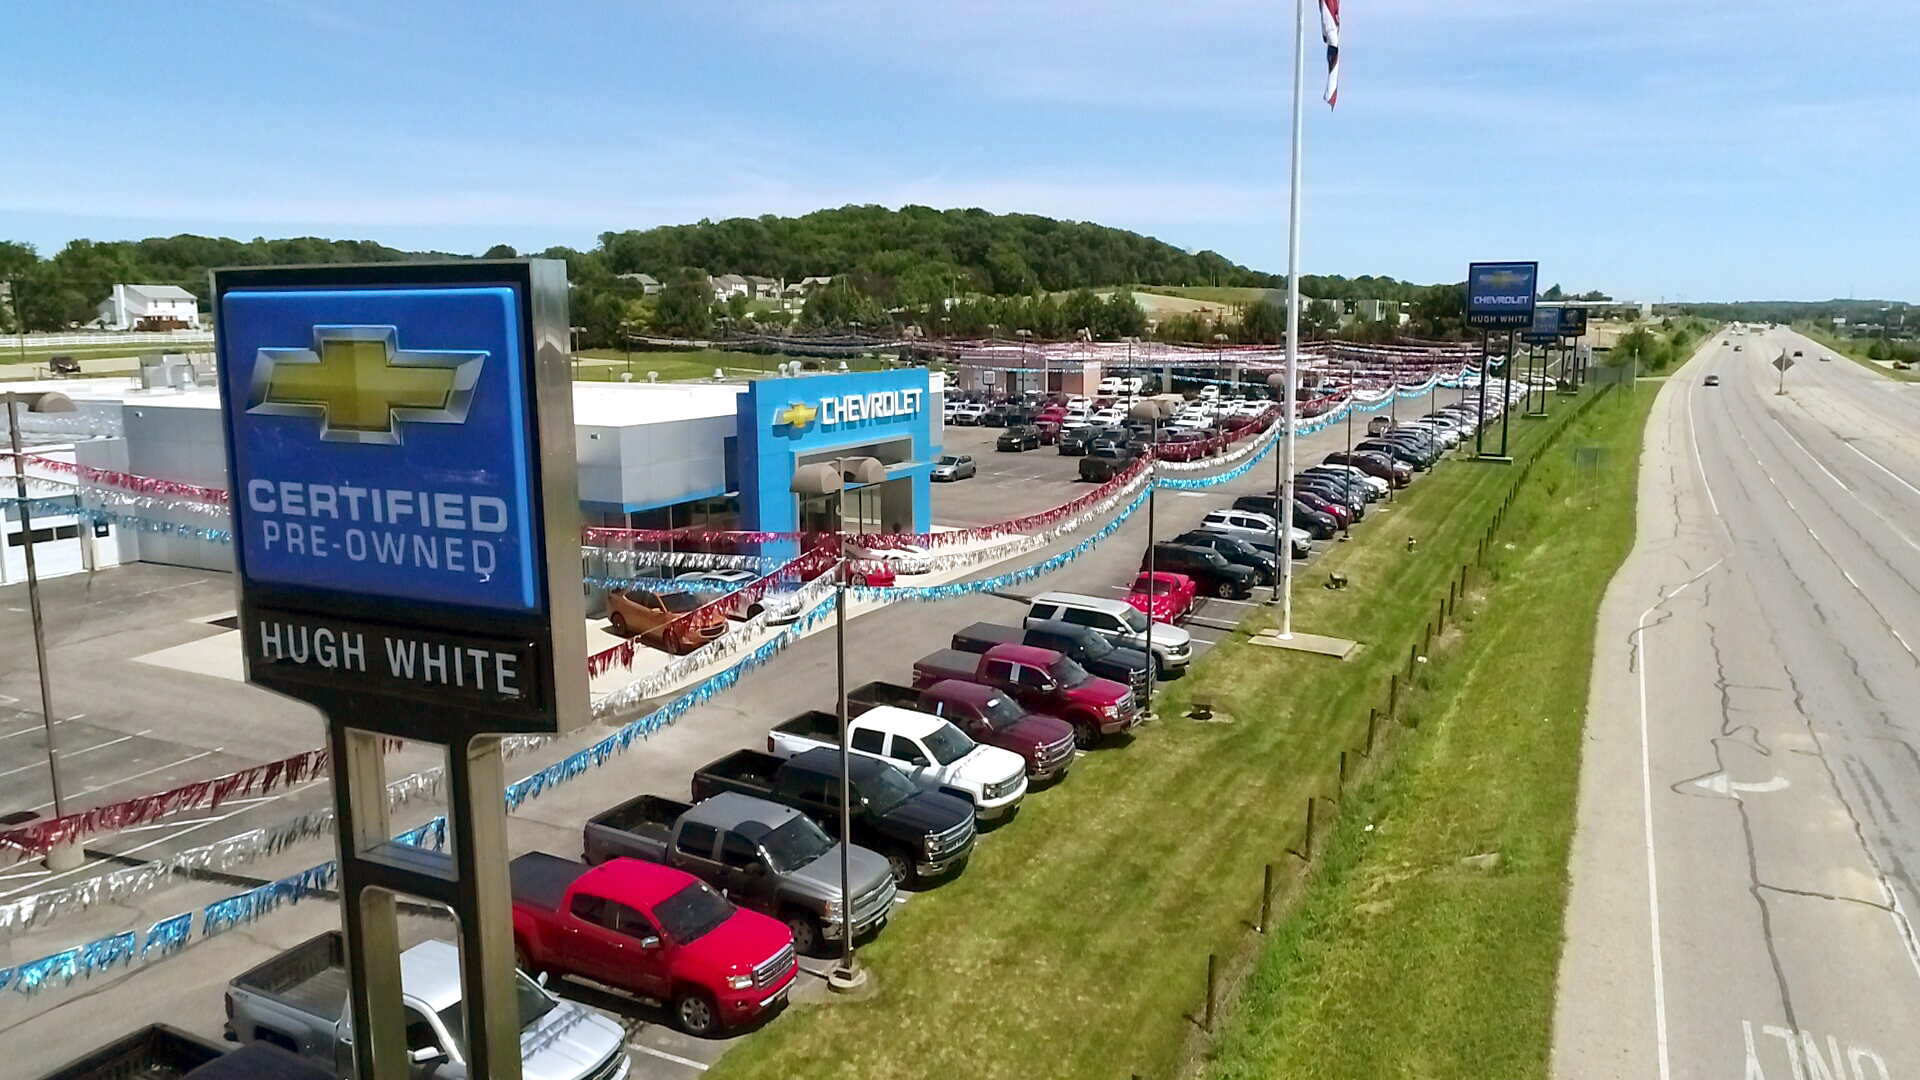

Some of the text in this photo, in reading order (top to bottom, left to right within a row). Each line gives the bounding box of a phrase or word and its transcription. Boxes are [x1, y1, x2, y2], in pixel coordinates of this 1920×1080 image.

[1470, 315, 1529, 323] HUGH WHITE
[1473, 295, 1529, 304] CHEVROLET
[820, 389, 923, 425] CHEVROLET
[247, 479, 508, 533] CERTIFIED
[263, 520, 496, 575] PRE-OWNED
[260, 621, 520, 695] HUGH WHITE
